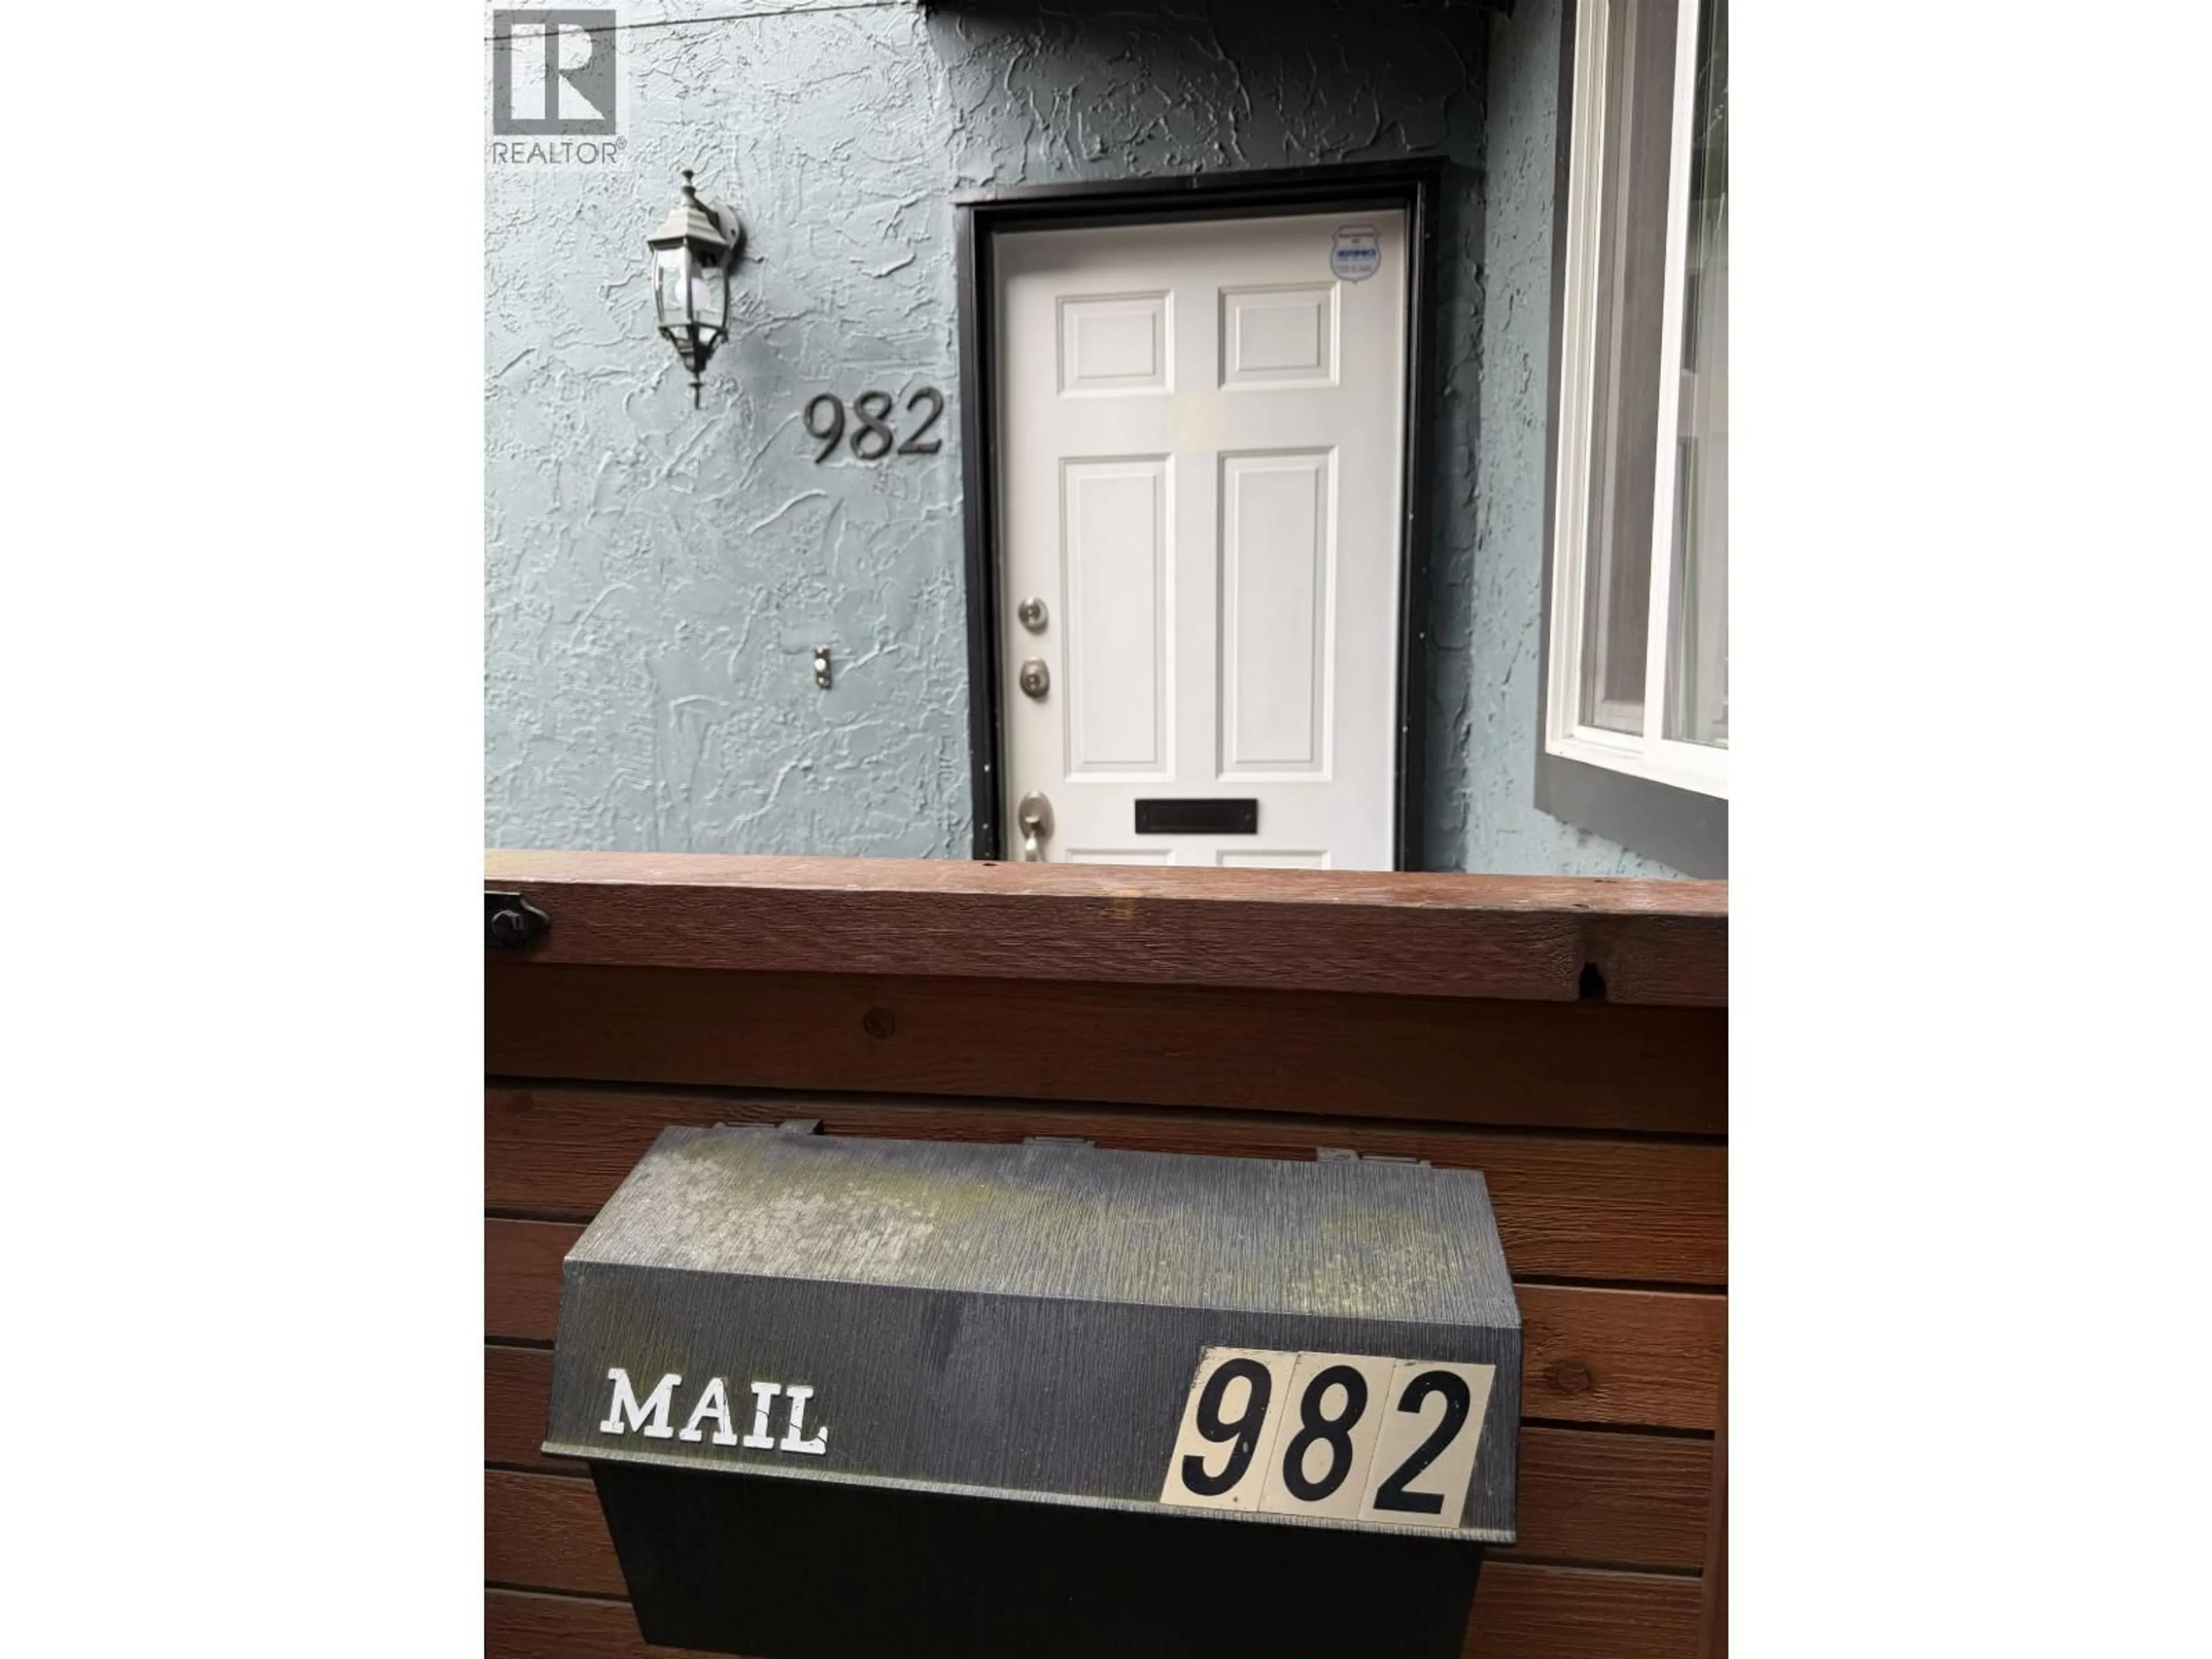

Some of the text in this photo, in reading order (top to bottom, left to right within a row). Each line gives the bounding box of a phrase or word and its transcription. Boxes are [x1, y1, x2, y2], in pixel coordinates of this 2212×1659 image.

[804, 386, 944, 464] 982
[600, 1368, 828, 1455] MAIL
[1181, 1358, 1471, 1514] 982
